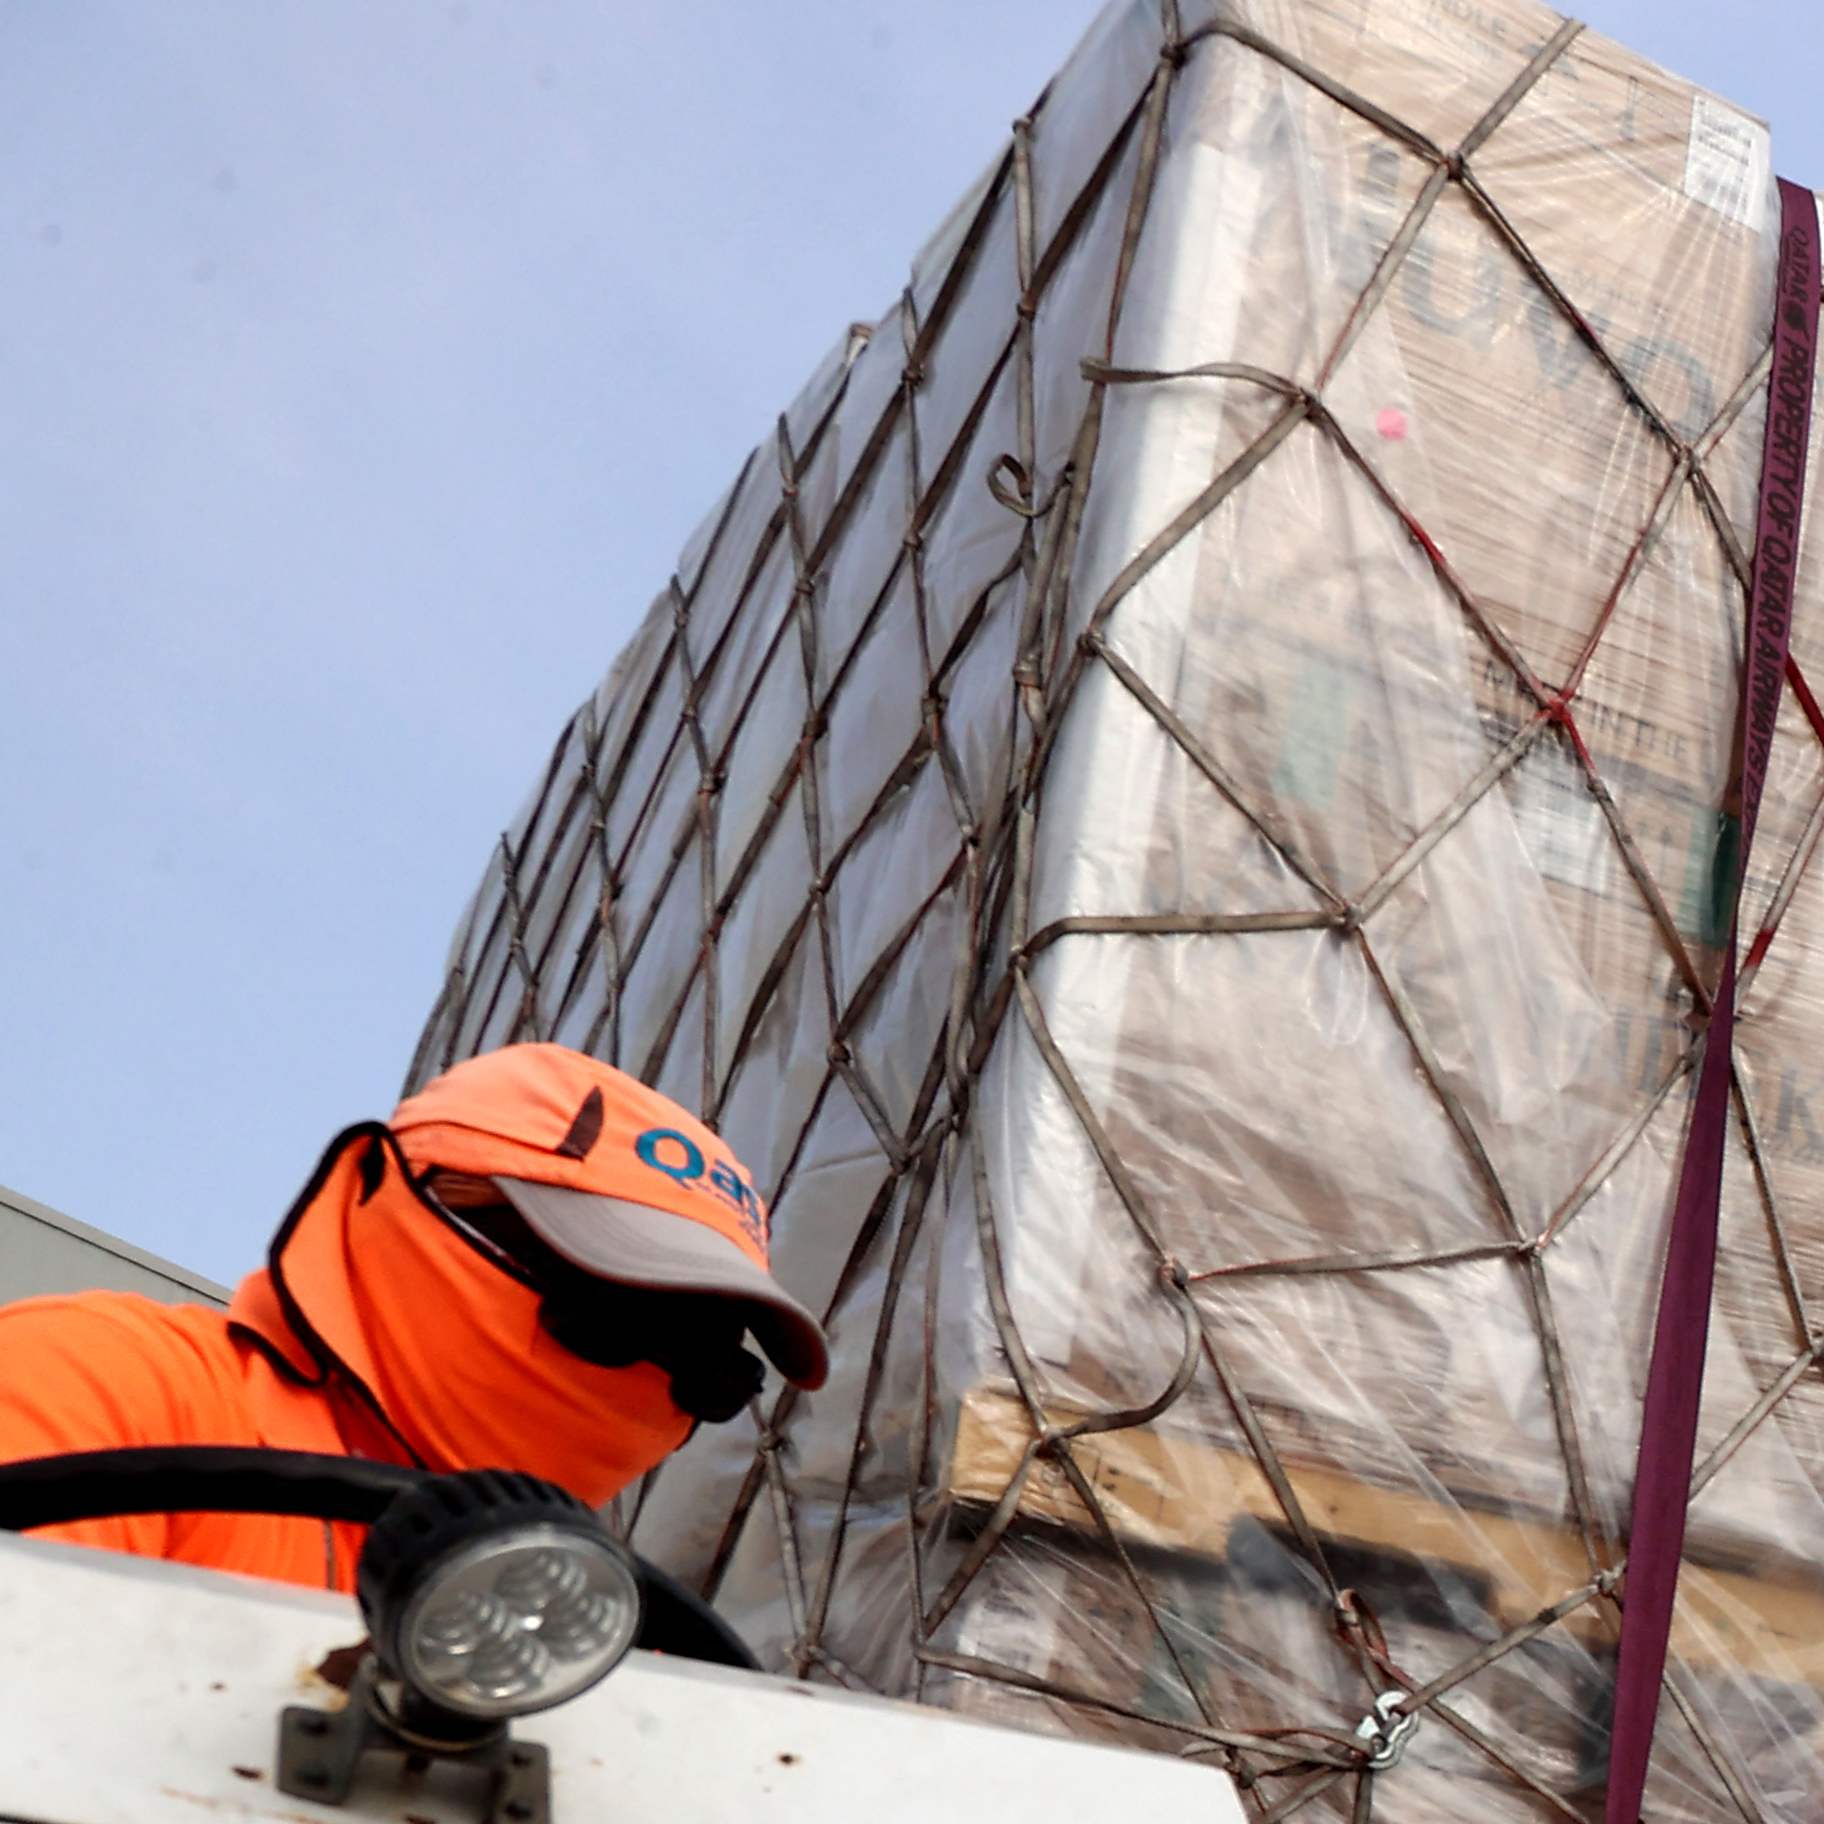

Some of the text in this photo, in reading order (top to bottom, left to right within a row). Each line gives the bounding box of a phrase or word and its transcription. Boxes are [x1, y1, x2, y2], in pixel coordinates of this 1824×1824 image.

[1772, 336, 1813, 491] PROPERTY
[1768, 492, 1800, 538] OF
[1757, 535, 1798, 633] QATAR
[1741, 632, 1788, 774] AIRWAYS
